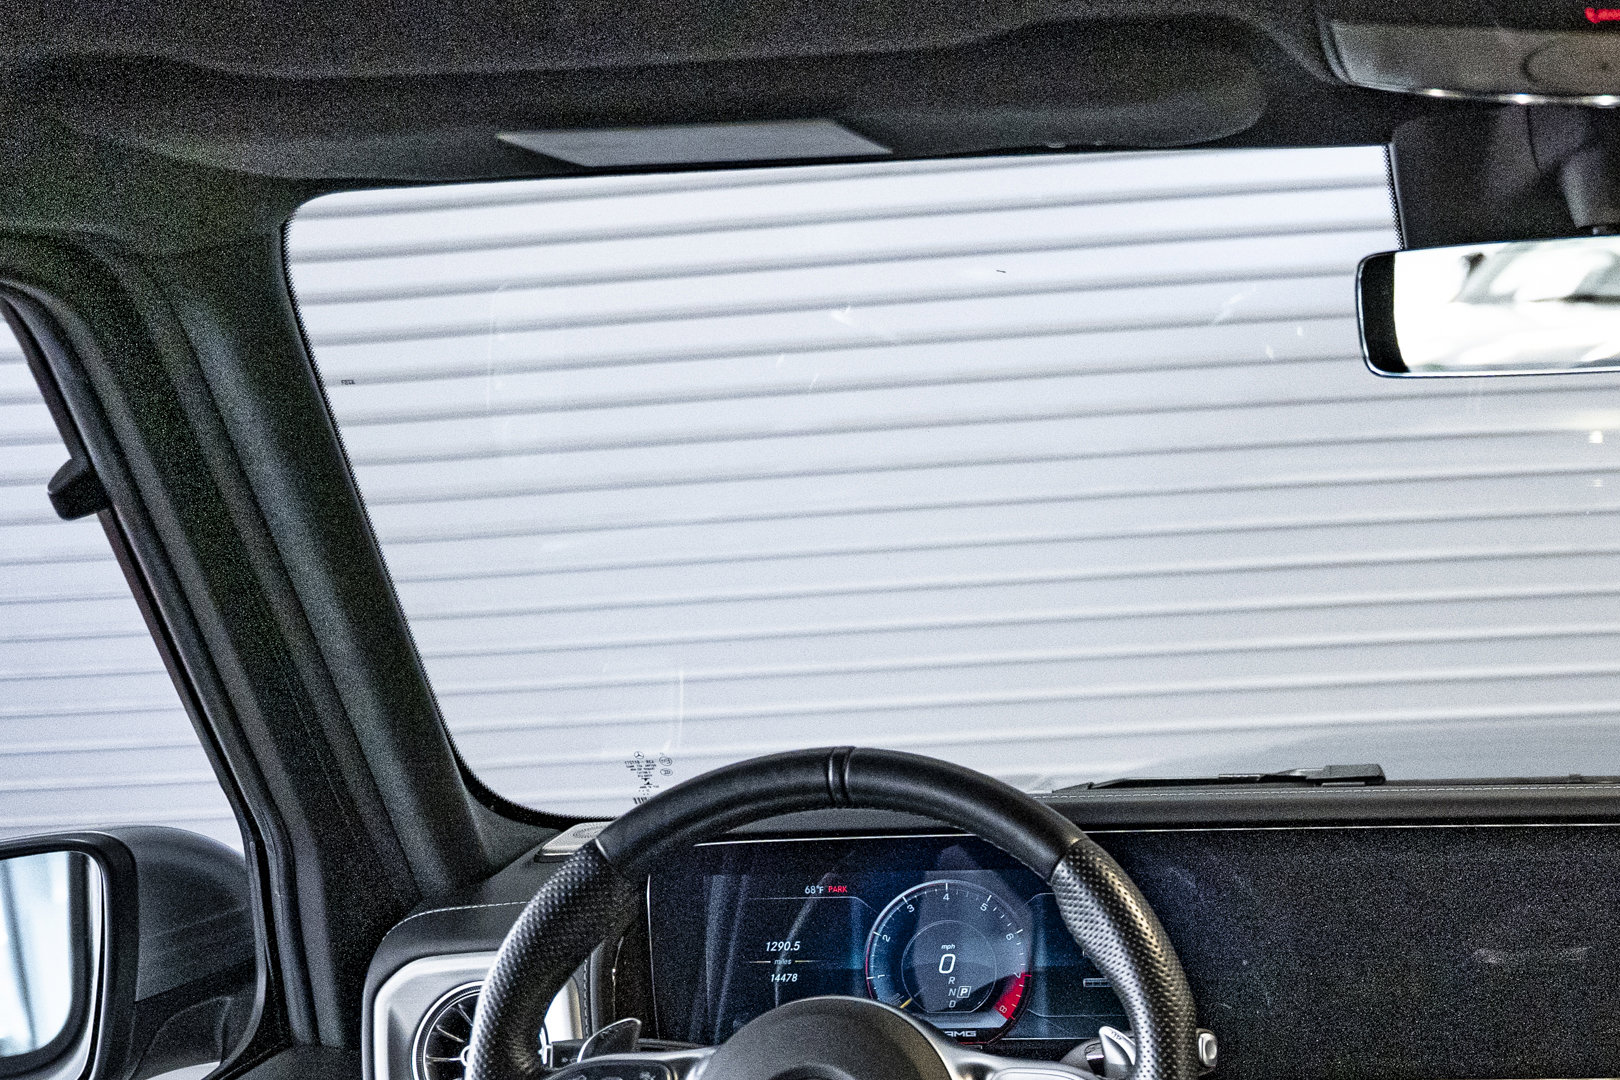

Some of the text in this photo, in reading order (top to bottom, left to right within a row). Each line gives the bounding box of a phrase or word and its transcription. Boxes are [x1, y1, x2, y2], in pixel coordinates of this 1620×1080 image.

[828, 885, 848, 893] PARK
[943, 893, 950, 901] 4
[906, 904, 915, 913] 3
[980, 903, 988, 912] 5
[882, 934, 891, 943] 2
[1005, 933, 1014, 941] 6
[765, 941, 801, 952] 1290.5
[938, 953, 956, 974] 0
[770, 973, 798, 982] 14478
[948, 976, 956, 985] R
[948, 988, 957, 996] N
[948, 1000, 956, 1008] D
